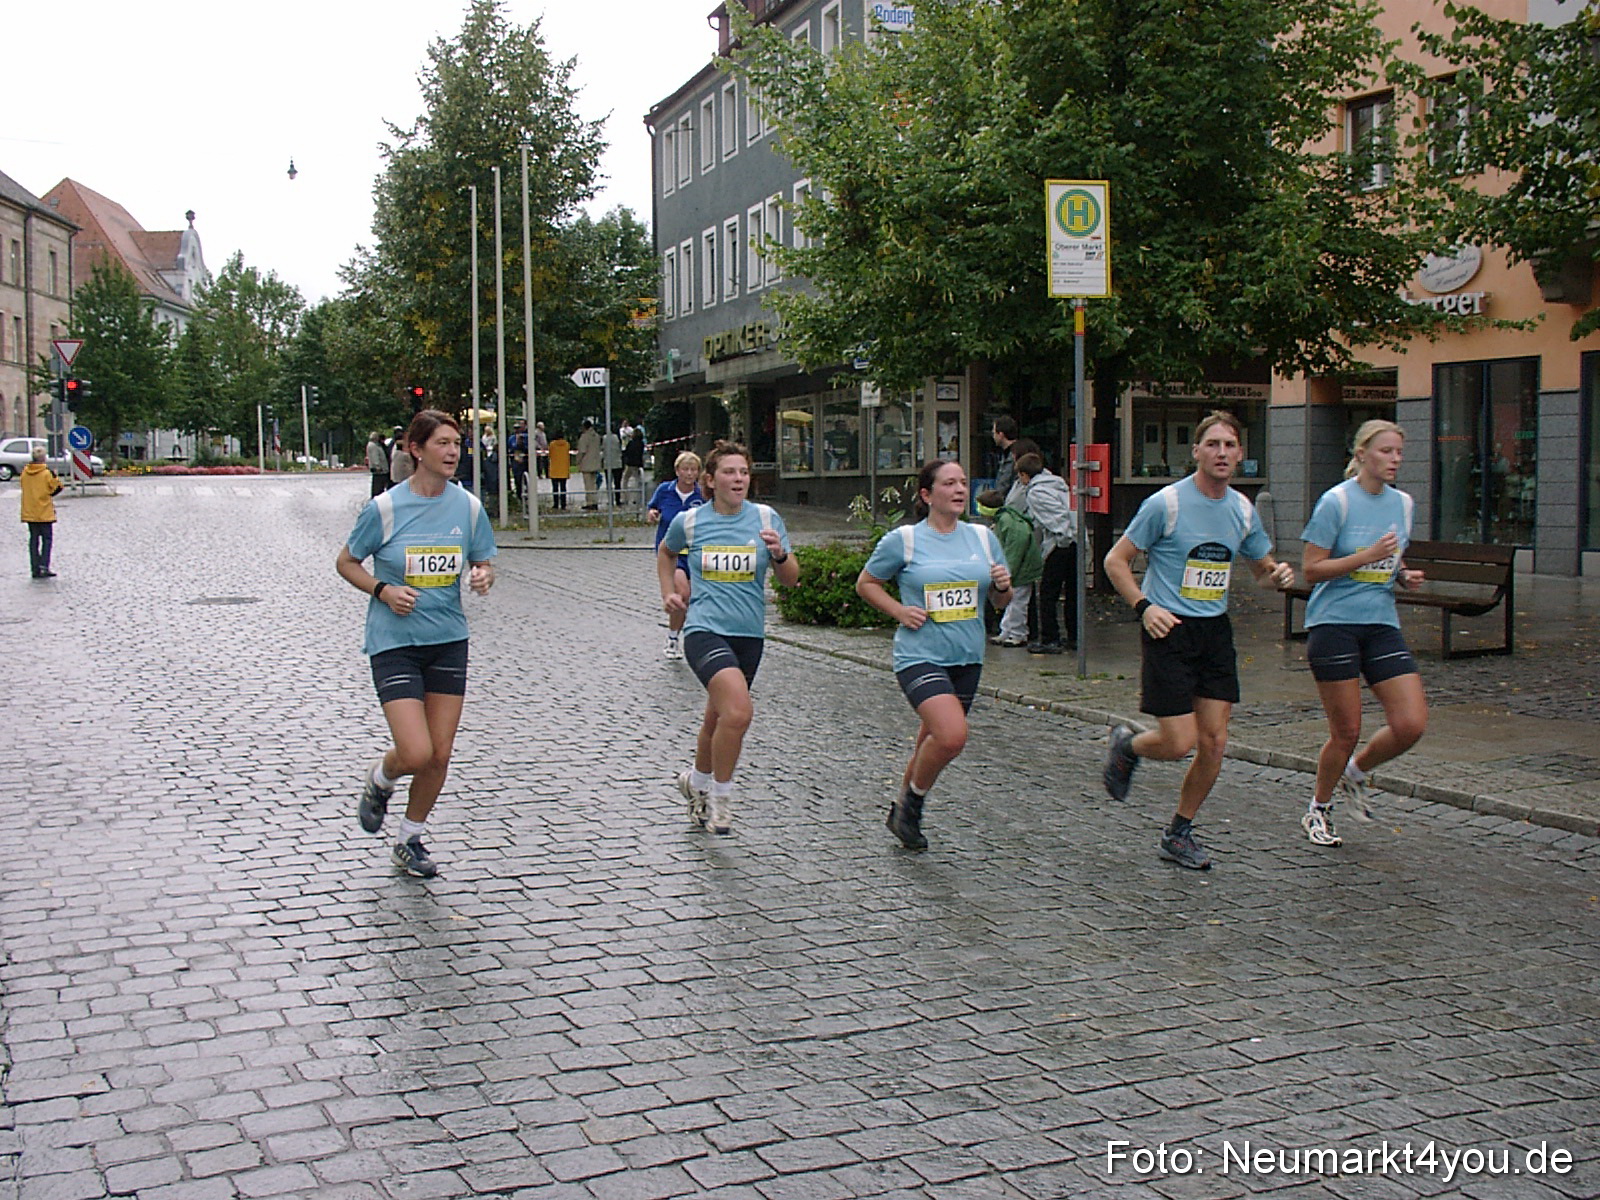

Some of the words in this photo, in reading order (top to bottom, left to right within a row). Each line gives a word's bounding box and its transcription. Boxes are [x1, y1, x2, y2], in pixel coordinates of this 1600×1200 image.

[1067, 199, 1089, 226] H
[581, 370, 601, 385] WC
[418, 555, 457, 573] 1624
[712, 554, 750, 571] 1101
[1196, 570, 1226, 587] 1622
[937, 588, 972, 607] 1623
